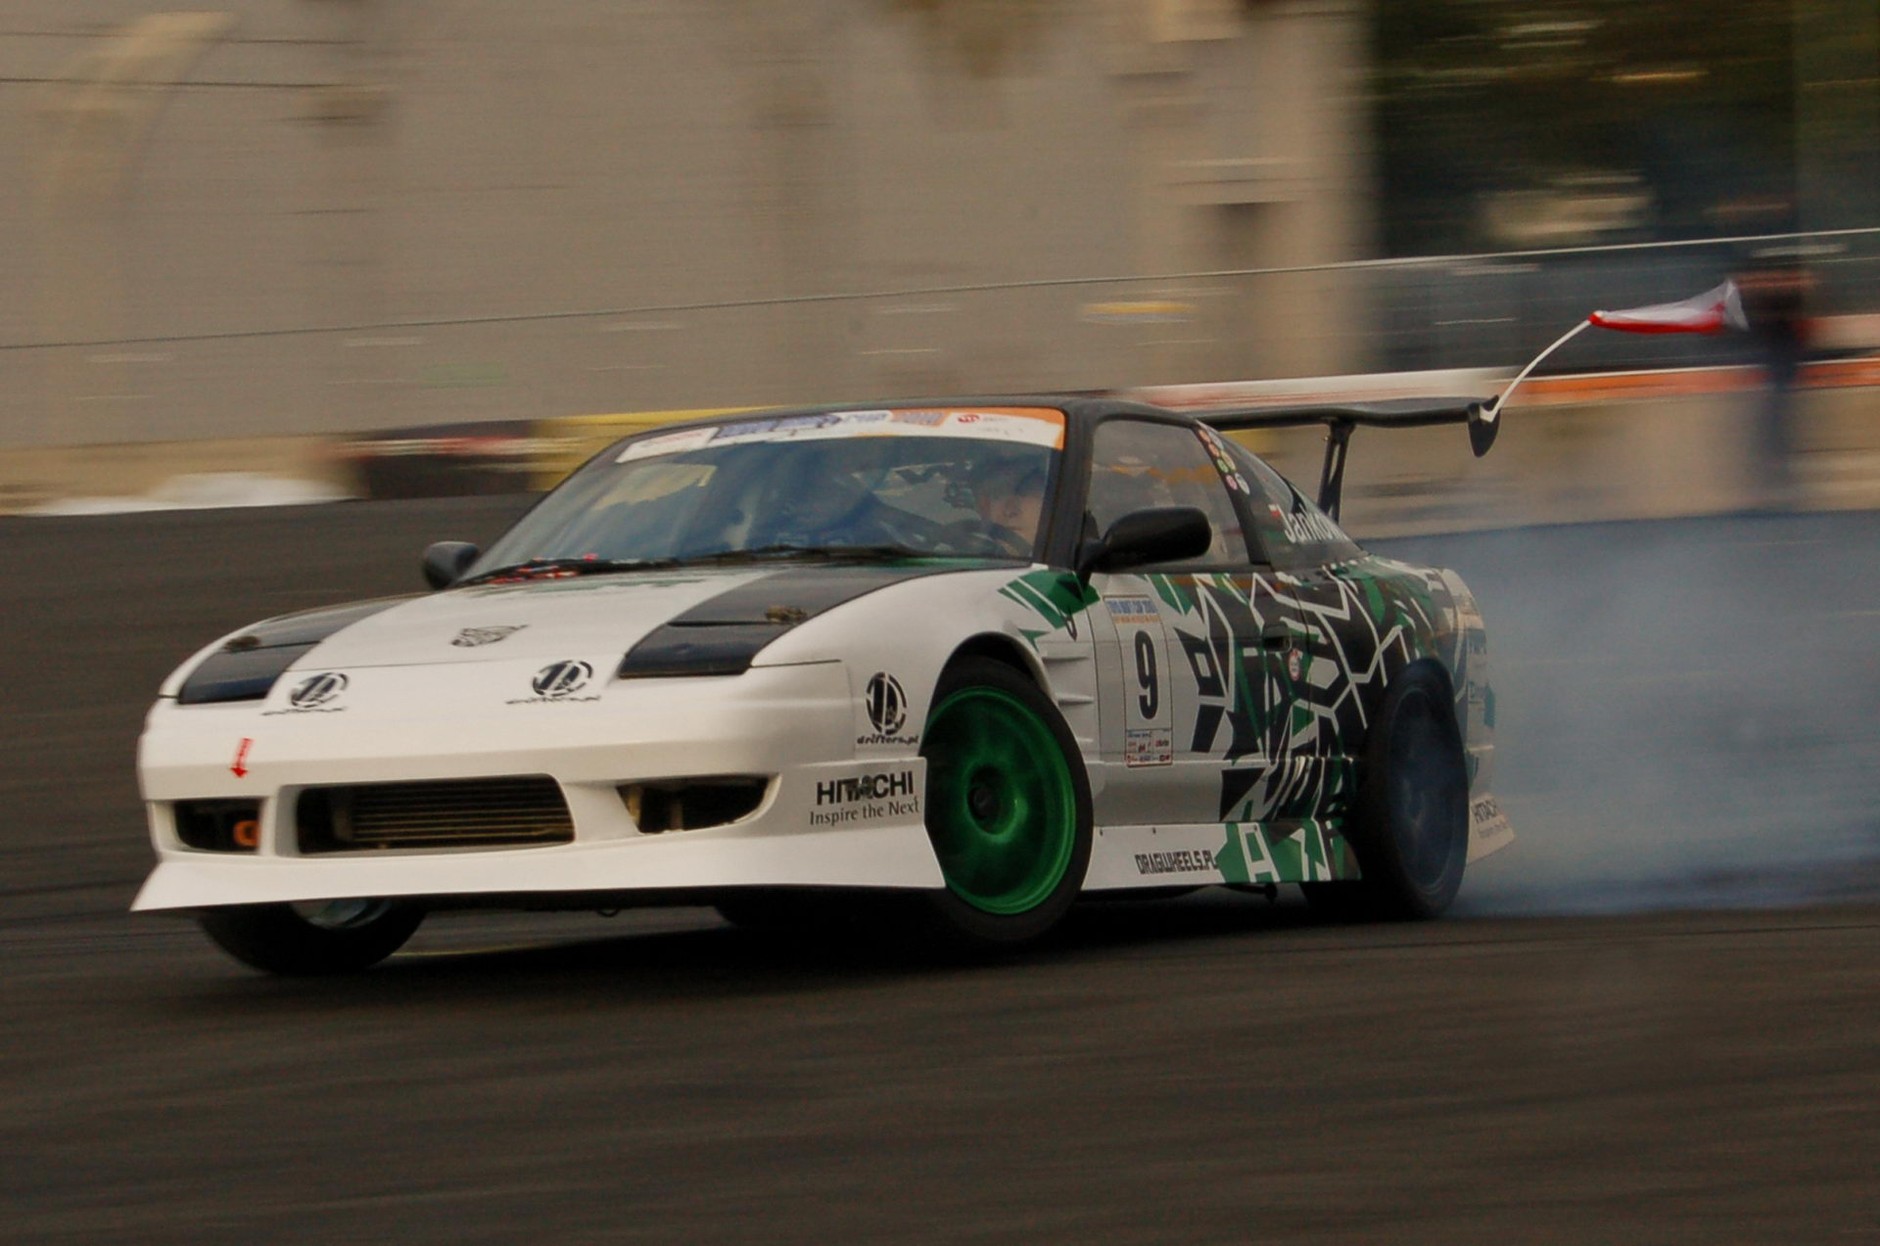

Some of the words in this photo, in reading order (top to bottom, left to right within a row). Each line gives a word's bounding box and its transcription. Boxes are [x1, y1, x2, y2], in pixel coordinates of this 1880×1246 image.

[1134, 630, 1159, 720] 9
[809, 807, 859, 827] Inspire
[862, 803, 885, 819] the
[888, 796, 920, 815] Next
[1134, 849, 1220, 875] DRAGWHEELS.PL
